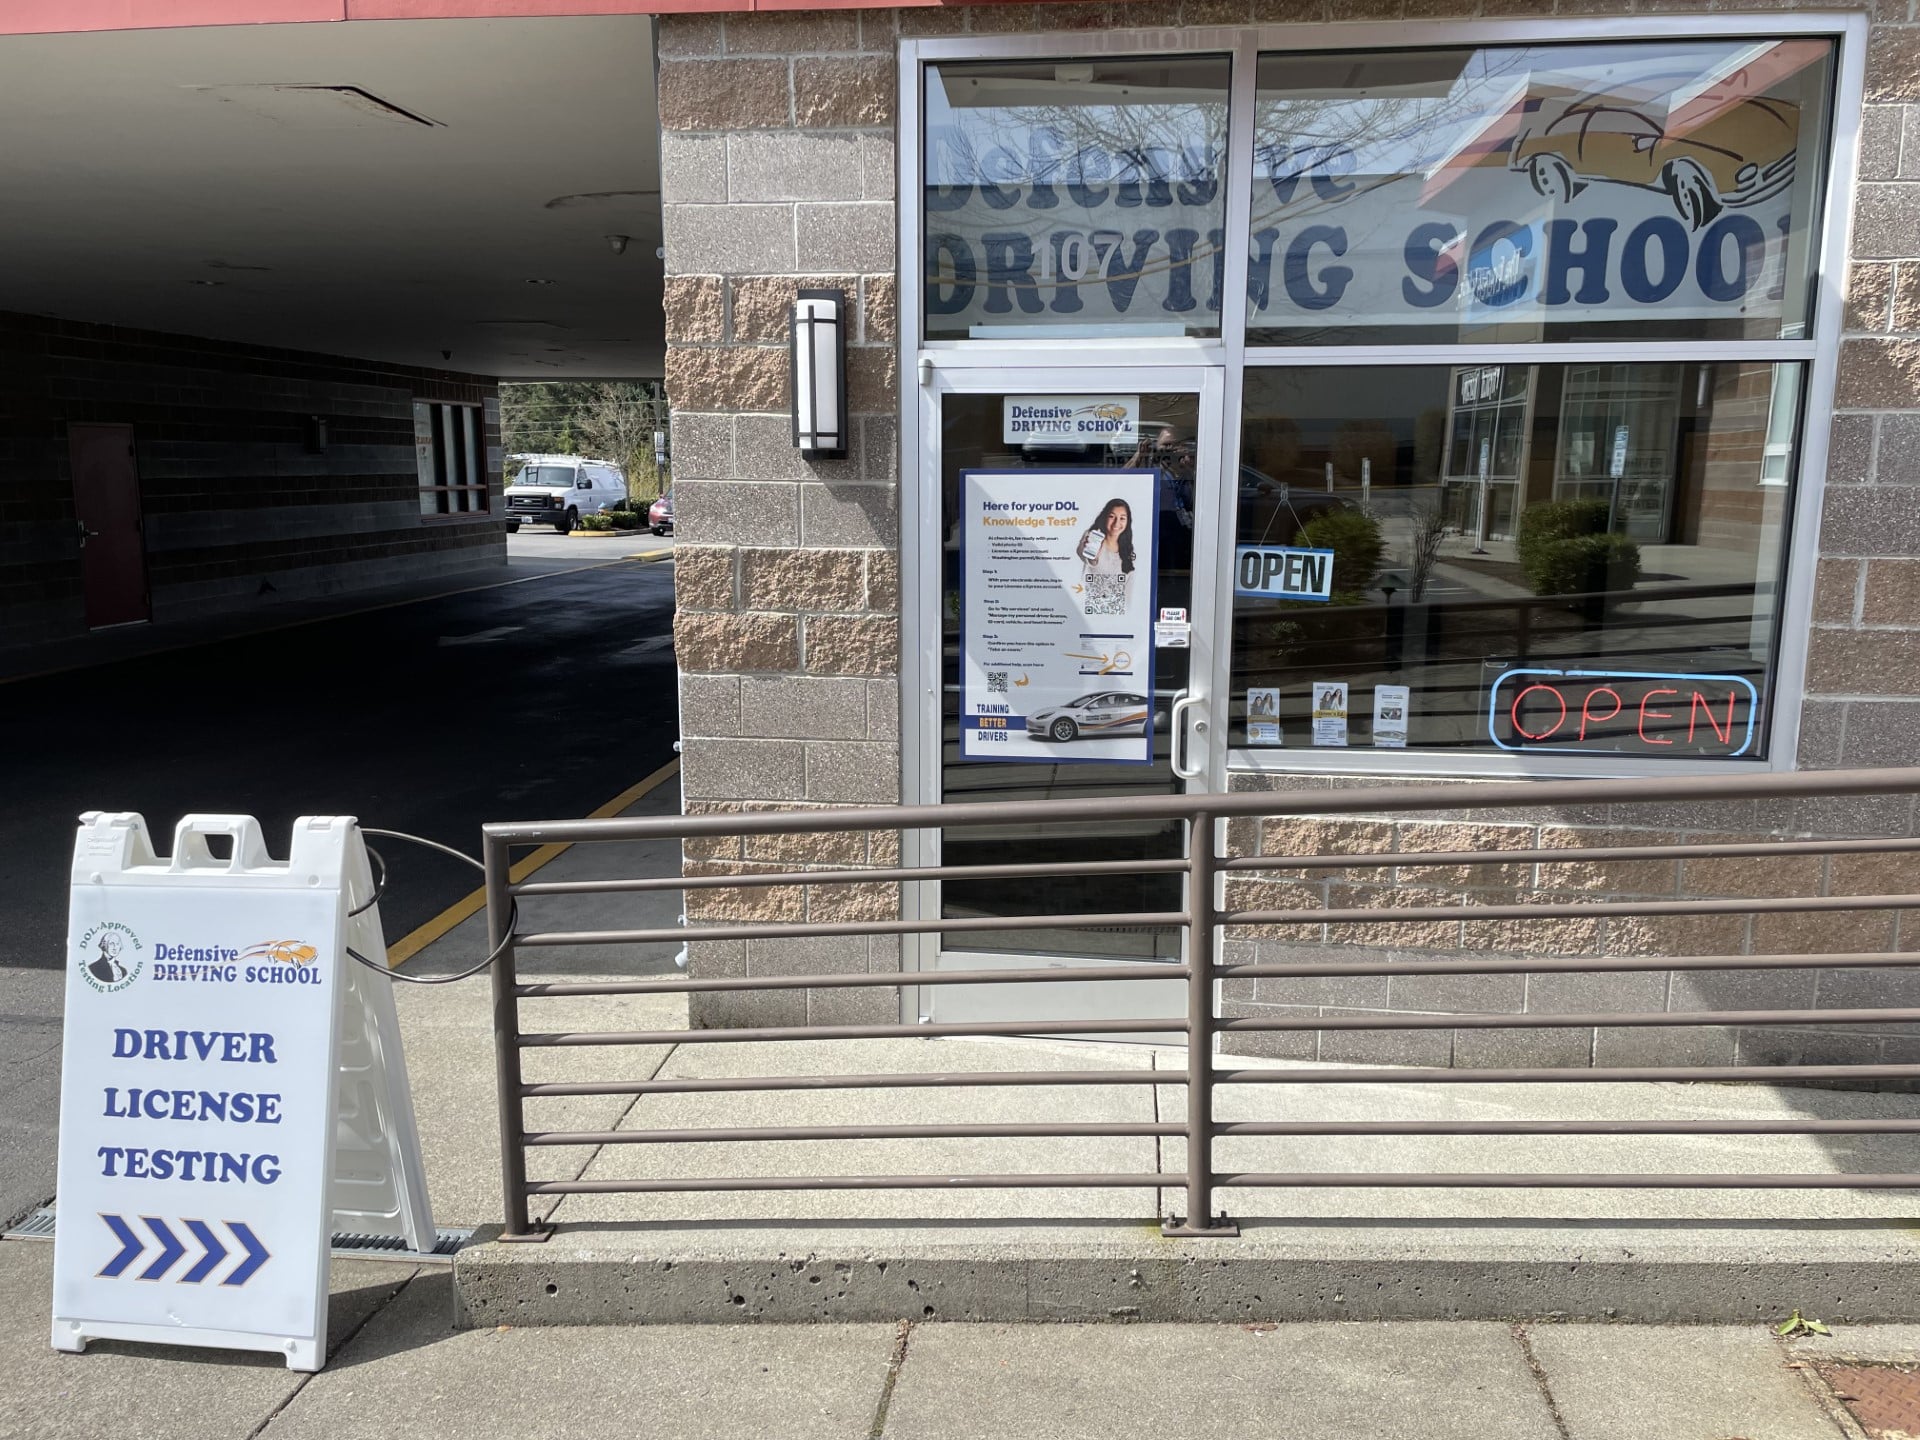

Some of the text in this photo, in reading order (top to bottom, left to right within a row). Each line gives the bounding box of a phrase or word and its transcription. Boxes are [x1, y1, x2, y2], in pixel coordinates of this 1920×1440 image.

[927, 124, 1357, 211] Defensve
[1030, 234, 1124, 281] 107
[1011, 405, 1072, 419] Defensive
[1011, 420, 1132, 432] DRIVING SCHOOL
[983, 501, 1079, 512] Here for your DOL
[983, 516, 1077, 528] Knowledge Test?
[1240, 551, 1326, 593] OPEN
[977, 703, 1010, 714] TRAINING
[1511, 684, 1736, 745] OPEN
[979, 717, 1007, 728] BETTER
[978, 731, 1008, 741] DRIVERS
[153, 943, 239, 962] Defensive
[78, 959, 144, 994] Testing Location
[153, 964, 322, 985] DRIVING SCHOOL
[112, 1028, 278, 1064] DRIVER
[102, 1087, 282, 1124] LICENSE
[97, 1147, 282, 1185] TESTING
